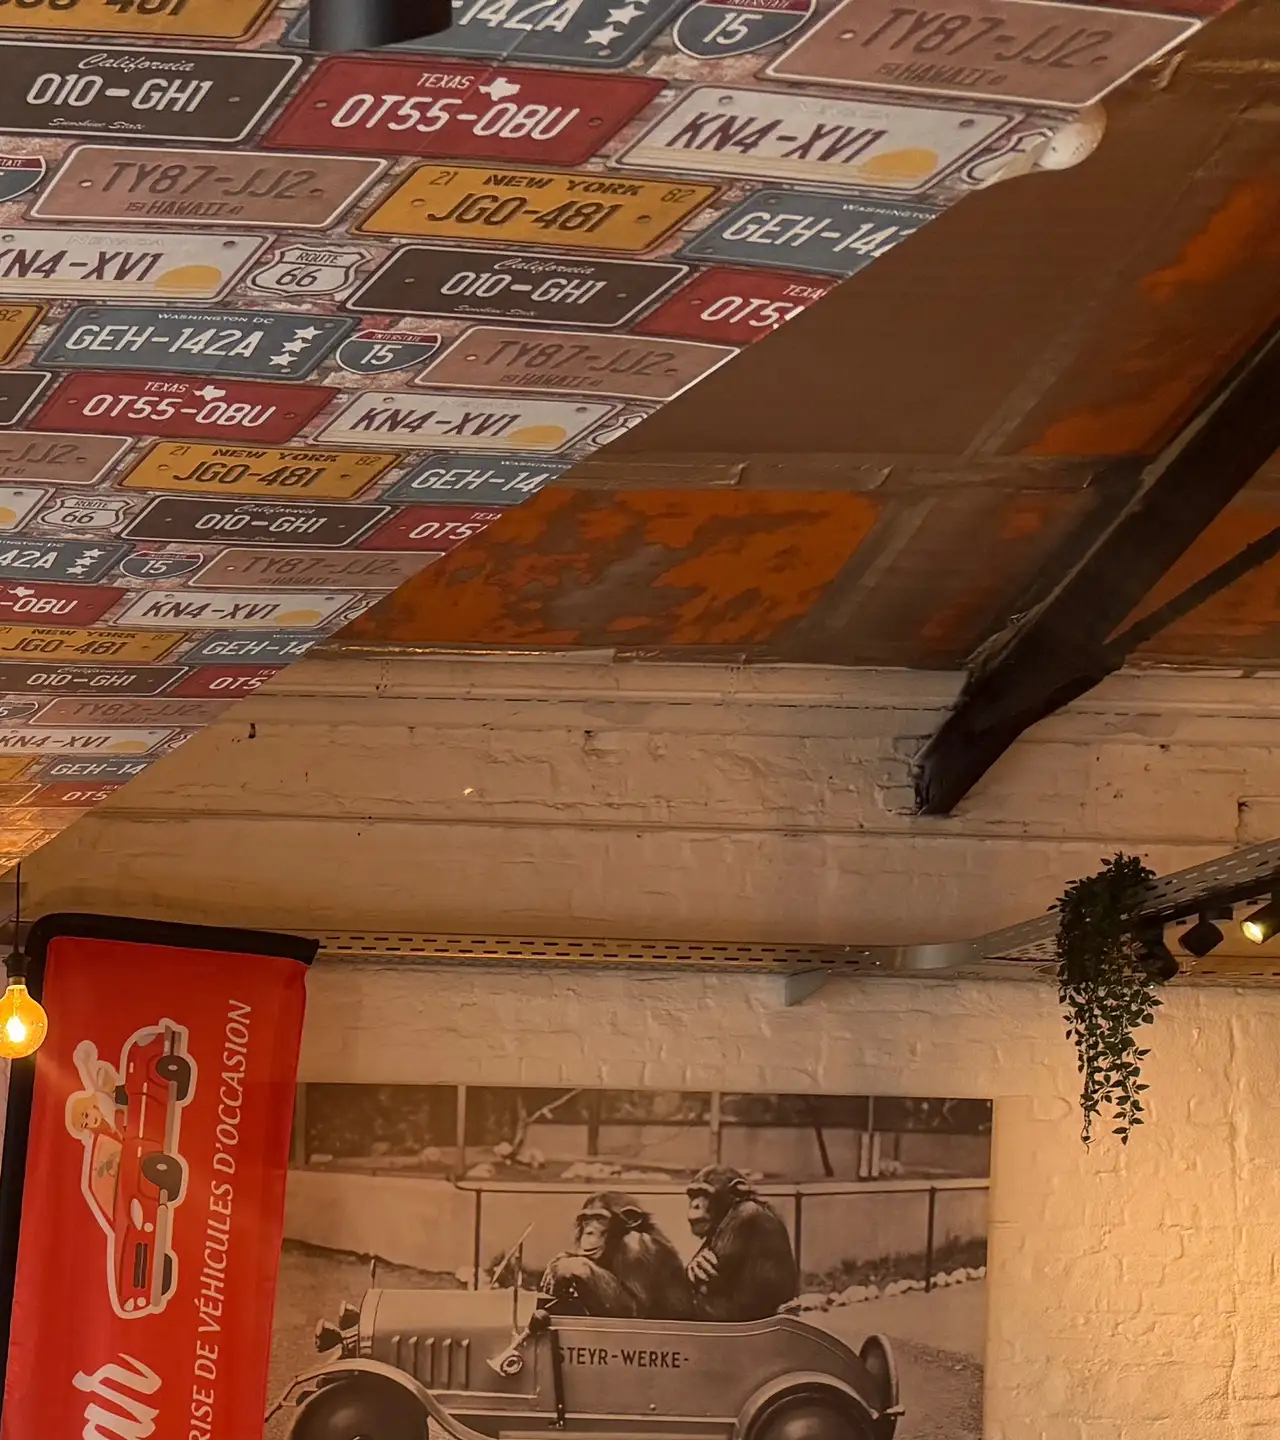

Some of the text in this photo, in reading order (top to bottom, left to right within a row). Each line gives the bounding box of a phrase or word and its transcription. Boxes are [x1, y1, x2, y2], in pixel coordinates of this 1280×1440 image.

[700, 13, 750, 46] 15
[76, 52, 195, 73] California
[416, 72, 474, 89] TEXAS
[428, 170, 458, 188] 21
[481, 173, 557, 190] NEW
[561, 175, 646, 196] YORK
[492, 257, 595, 274] California
[64, 323, 264, 357] GEH-142A
[359, 343, 402, 365] 15
[212, 999, 252, 1174] D'OCCASION
[193, 1180, 234, 1333] VÉHICULES
[194, 1340, 219, 1381] DE
